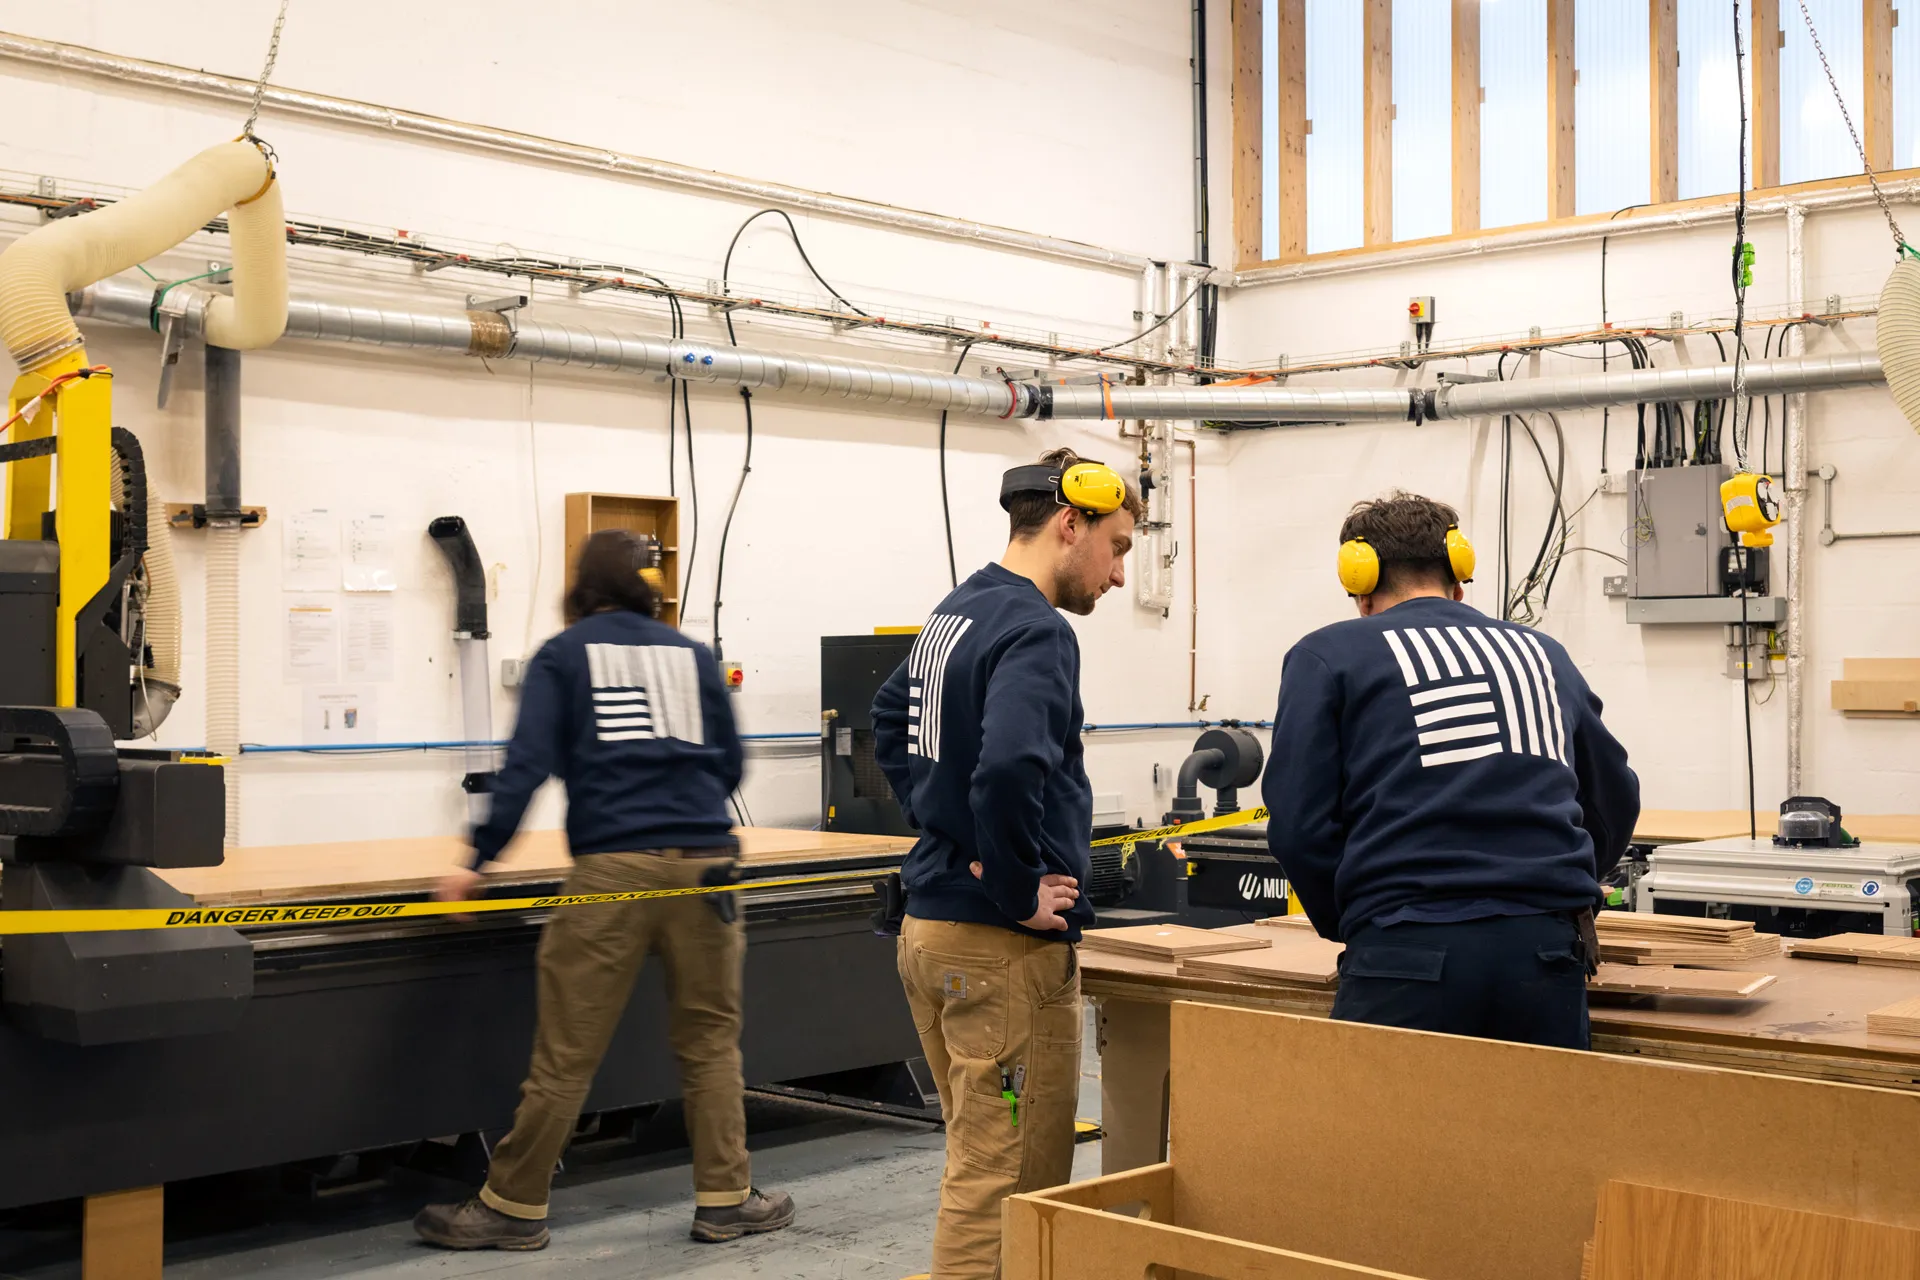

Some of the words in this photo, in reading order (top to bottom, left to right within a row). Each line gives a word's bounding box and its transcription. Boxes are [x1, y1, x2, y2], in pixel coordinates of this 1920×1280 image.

[531, 893, 623, 907] DANGER
[166, 908, 279, 926] DANGER
[281, 907, 353, 921] KEEP
[353, 904, 406, 917] OUT
